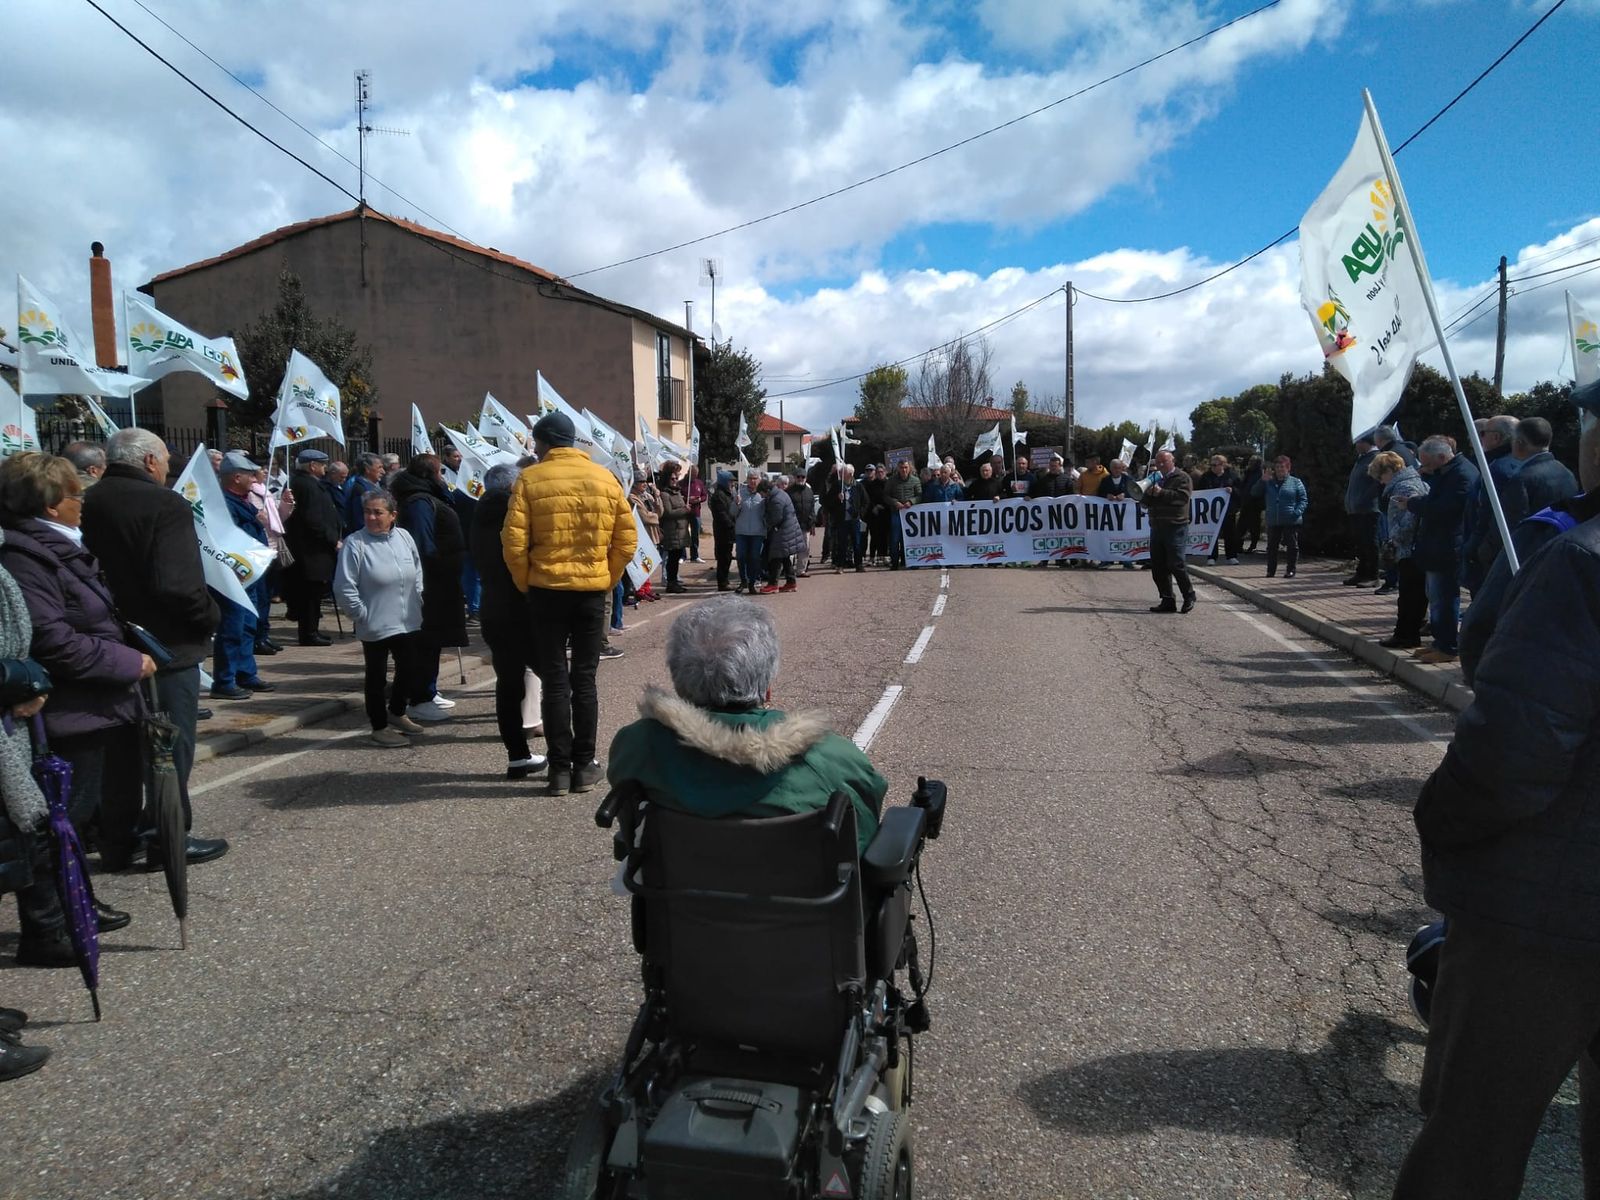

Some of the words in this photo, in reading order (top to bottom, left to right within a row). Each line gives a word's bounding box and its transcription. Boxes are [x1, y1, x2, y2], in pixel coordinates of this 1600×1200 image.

[166, 331, 194, 350] UPA
[905, 510, 941, 537] SIN
[948, 503, 1044, 537] MÉDICOS
[1048, 503, 1078, 530] NO
[1084, 503, 1126, 531] HAY
[967, 543, 1004, 555] COAG
[1033, 536, 1085, 551] COAG
[1110, 540, 1149, 552] COAG
[203, 545, 215, 557] del
[906, 545, 943, 557] COAG
